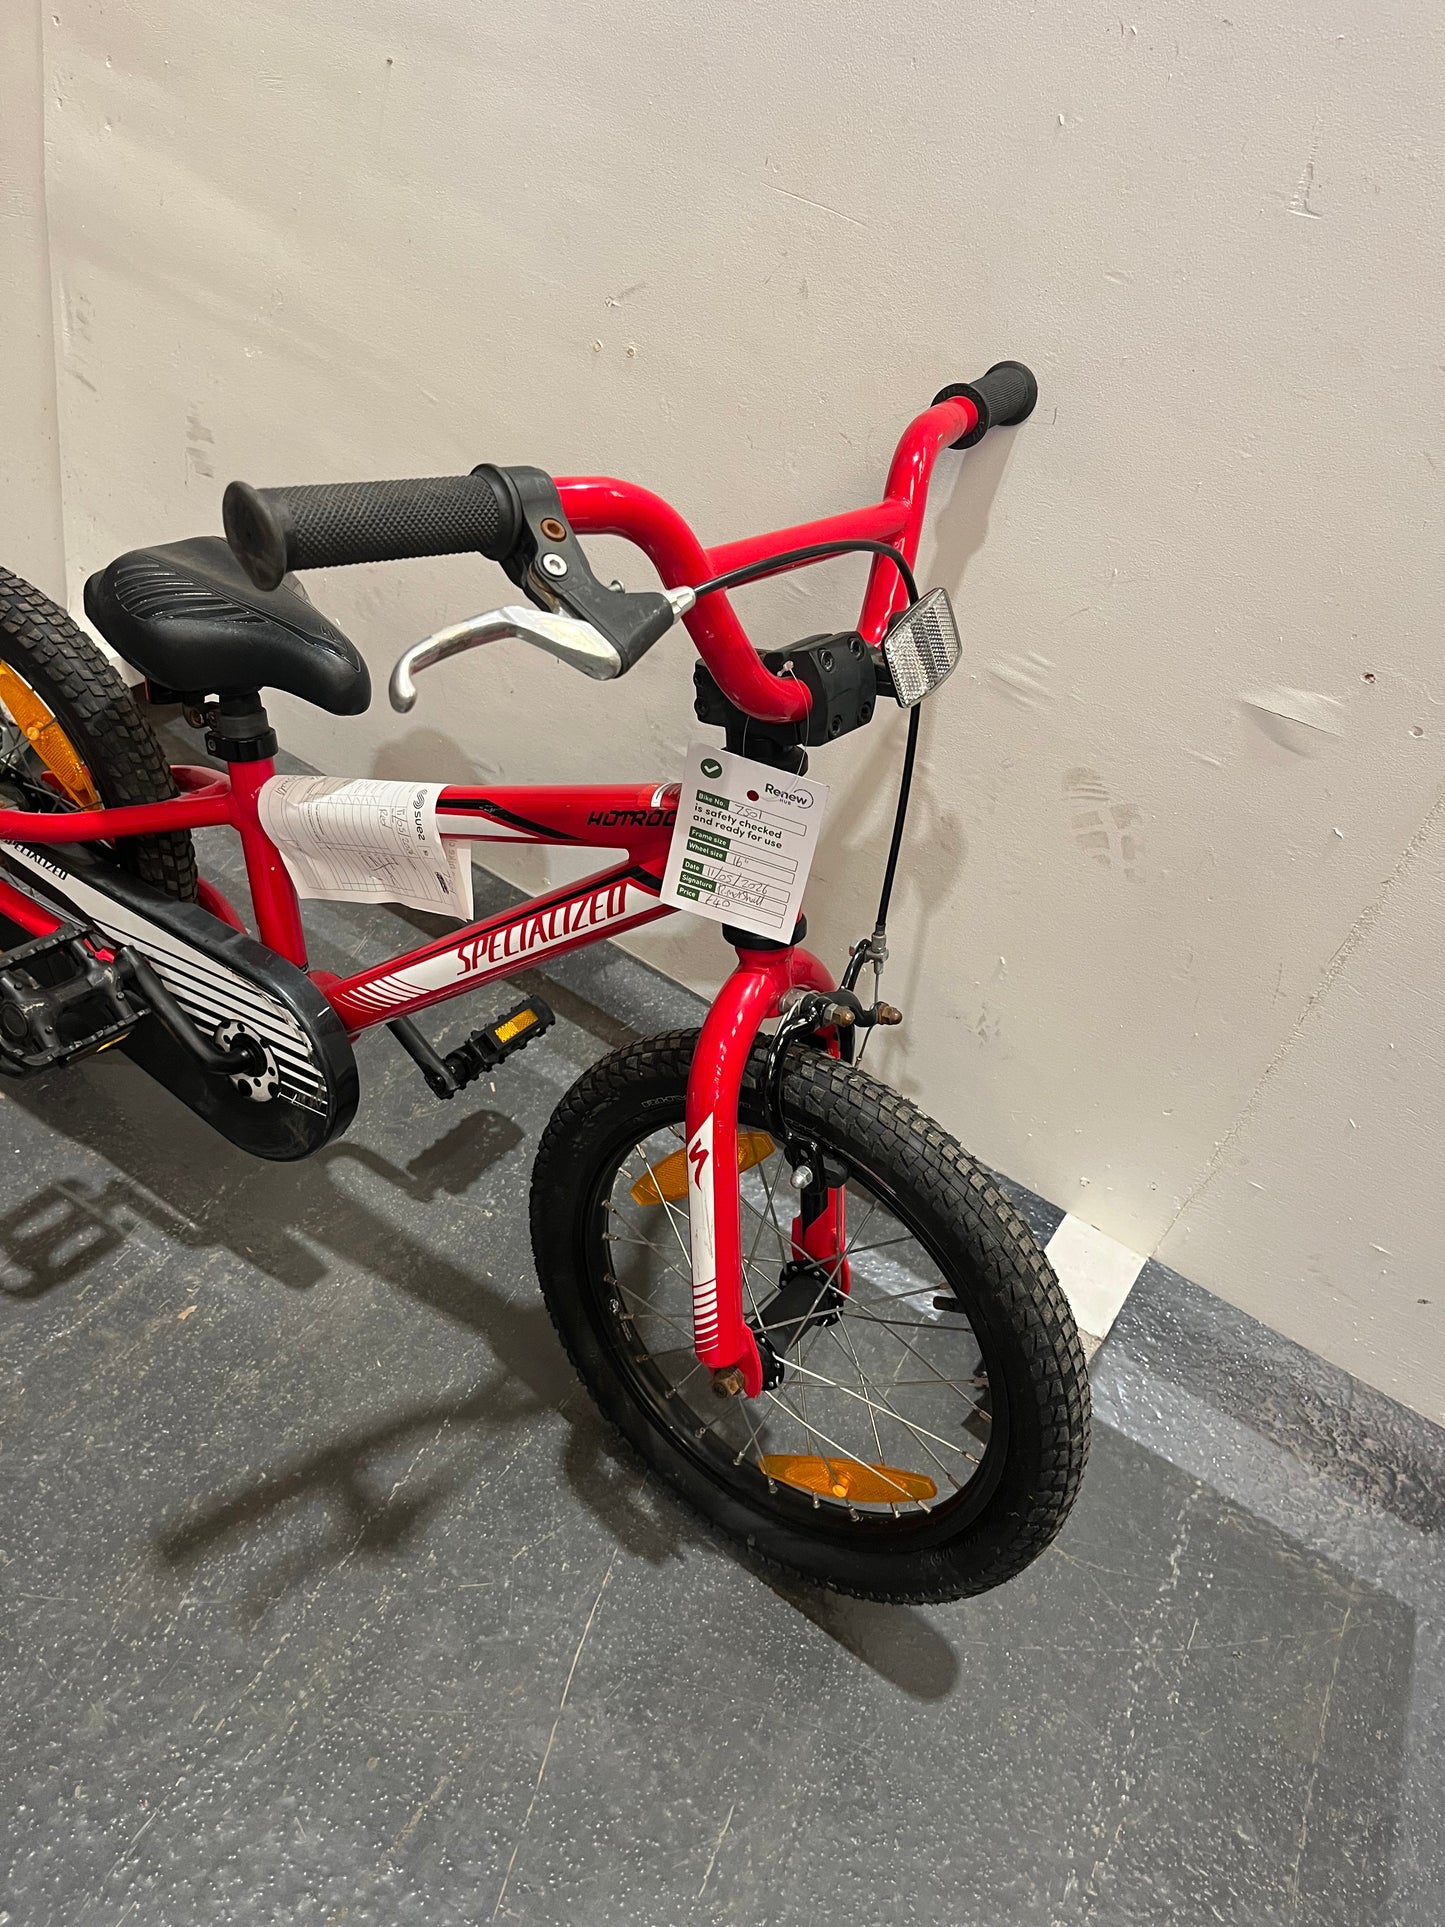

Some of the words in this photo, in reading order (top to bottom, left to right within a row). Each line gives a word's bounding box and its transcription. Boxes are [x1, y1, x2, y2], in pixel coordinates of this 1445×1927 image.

[698, 792, 713, 803] Bike
[714, 798, 726, 808] No.
[765, 783, 808, 806] Renew
[414, 811, 426, 841] suez
[586, 810, 678, 827] HOTROC
[694, 803, 703, 813] is
[706, 807, 737, 825] safety
[739, 819, 782, 839] checked
[691, 829, 713, 842] Frame
[713, 836, 727, 846] size
[693, 814, 713, 826] and
[715, 821, 745, 838] ready
[747, 830, 762, 842] for
[764, 838, 783, 849] use
[688, 842, 710, 854] Wheel
[710, 848, 724, 858] size
[684, 861, 700, 871] Date
[682, 874, 713, 889] Signature
[679, 887, 696, 898] Price
[457, 882, 628, 976] SPECIALIZED
